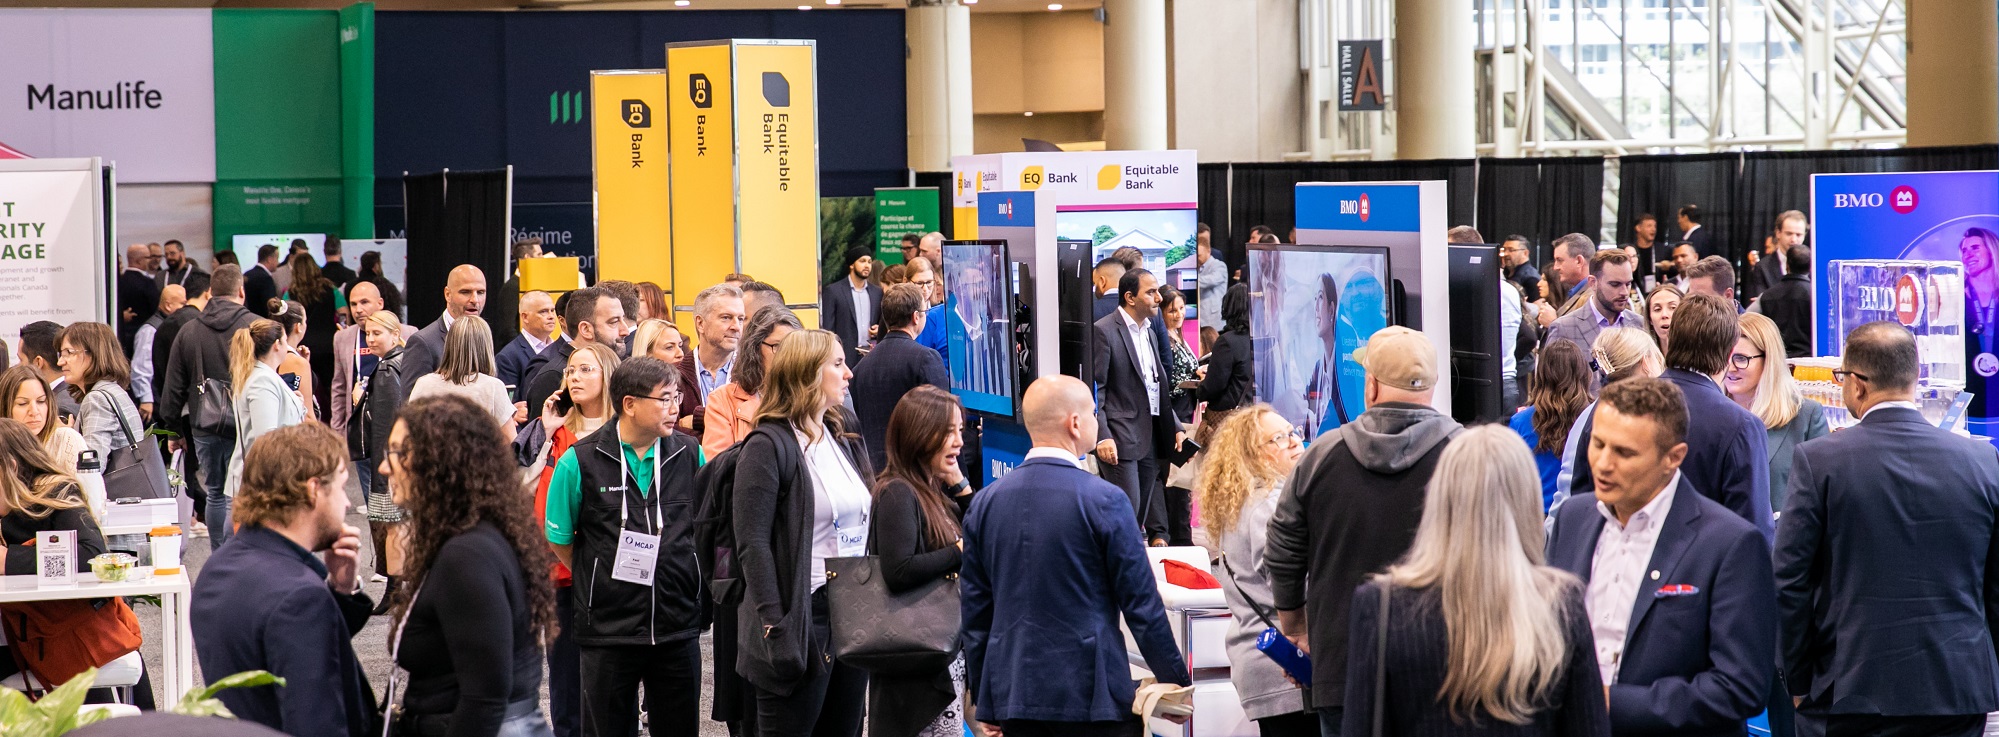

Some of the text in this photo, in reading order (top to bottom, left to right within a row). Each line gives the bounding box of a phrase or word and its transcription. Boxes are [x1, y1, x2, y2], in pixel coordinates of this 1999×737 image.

[1342, 45, 1353, 106] HALL SALLE
[1353, 46, 1384, 105] A
[27, 80, 162, 110] Manulife
[695, 79, 707, 157] EQ Bank
[629, 103, 644, 168] EQ Bank
[763, 113, 774, 154] Bank
[776, 113, 790, 191] Equitable
[1024, 172, 1077, 184] EQ Bank
[1125, 164, 1179, 177] Equitable
[1125, 179, 1153, 189] Bank
[1340, 199, 1358, 214] BMO
[1834, 193, 1884, 208] BMO
[1, 244, 46, 260] AGE
[40, 266, 65, 276] growth
[18, 308, 28, 316] will
[30, 308, 54, 316] benefit
[992, 458, 1003, 478] BMO
[634, 541, 654, 550] MCAP
